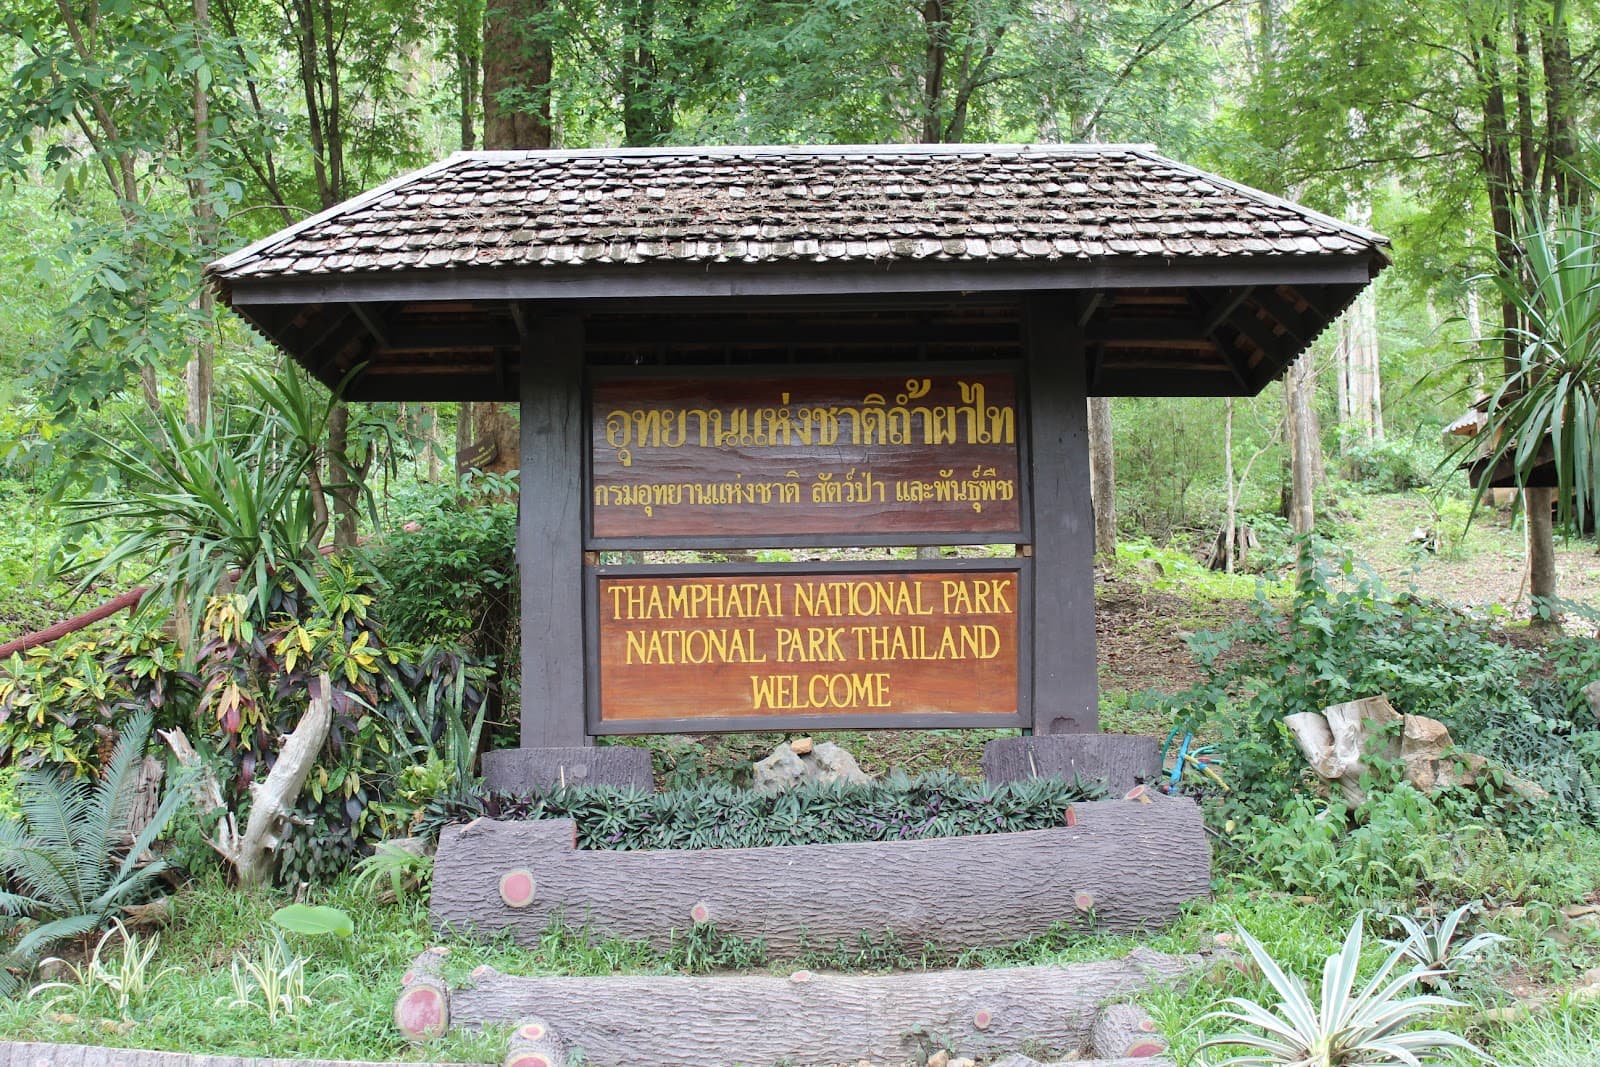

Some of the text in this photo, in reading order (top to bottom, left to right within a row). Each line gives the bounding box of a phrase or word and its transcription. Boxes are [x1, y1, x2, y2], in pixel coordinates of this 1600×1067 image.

[606, 378, 1014, 467] อุทยานแห่งชาติถ้ำผาไท
[593, 464, 1014, 517] กรมอุทยานแห่งชาติ สัตว์ป่า และพันธุ์พืช
[607, 579, 1013, 620] THAMPHATAI NATIONAL PARK
[625, 624, 1001, 665] NATIONAL PARK THAILAND
[750, 673, 892, 710] WELCOME
